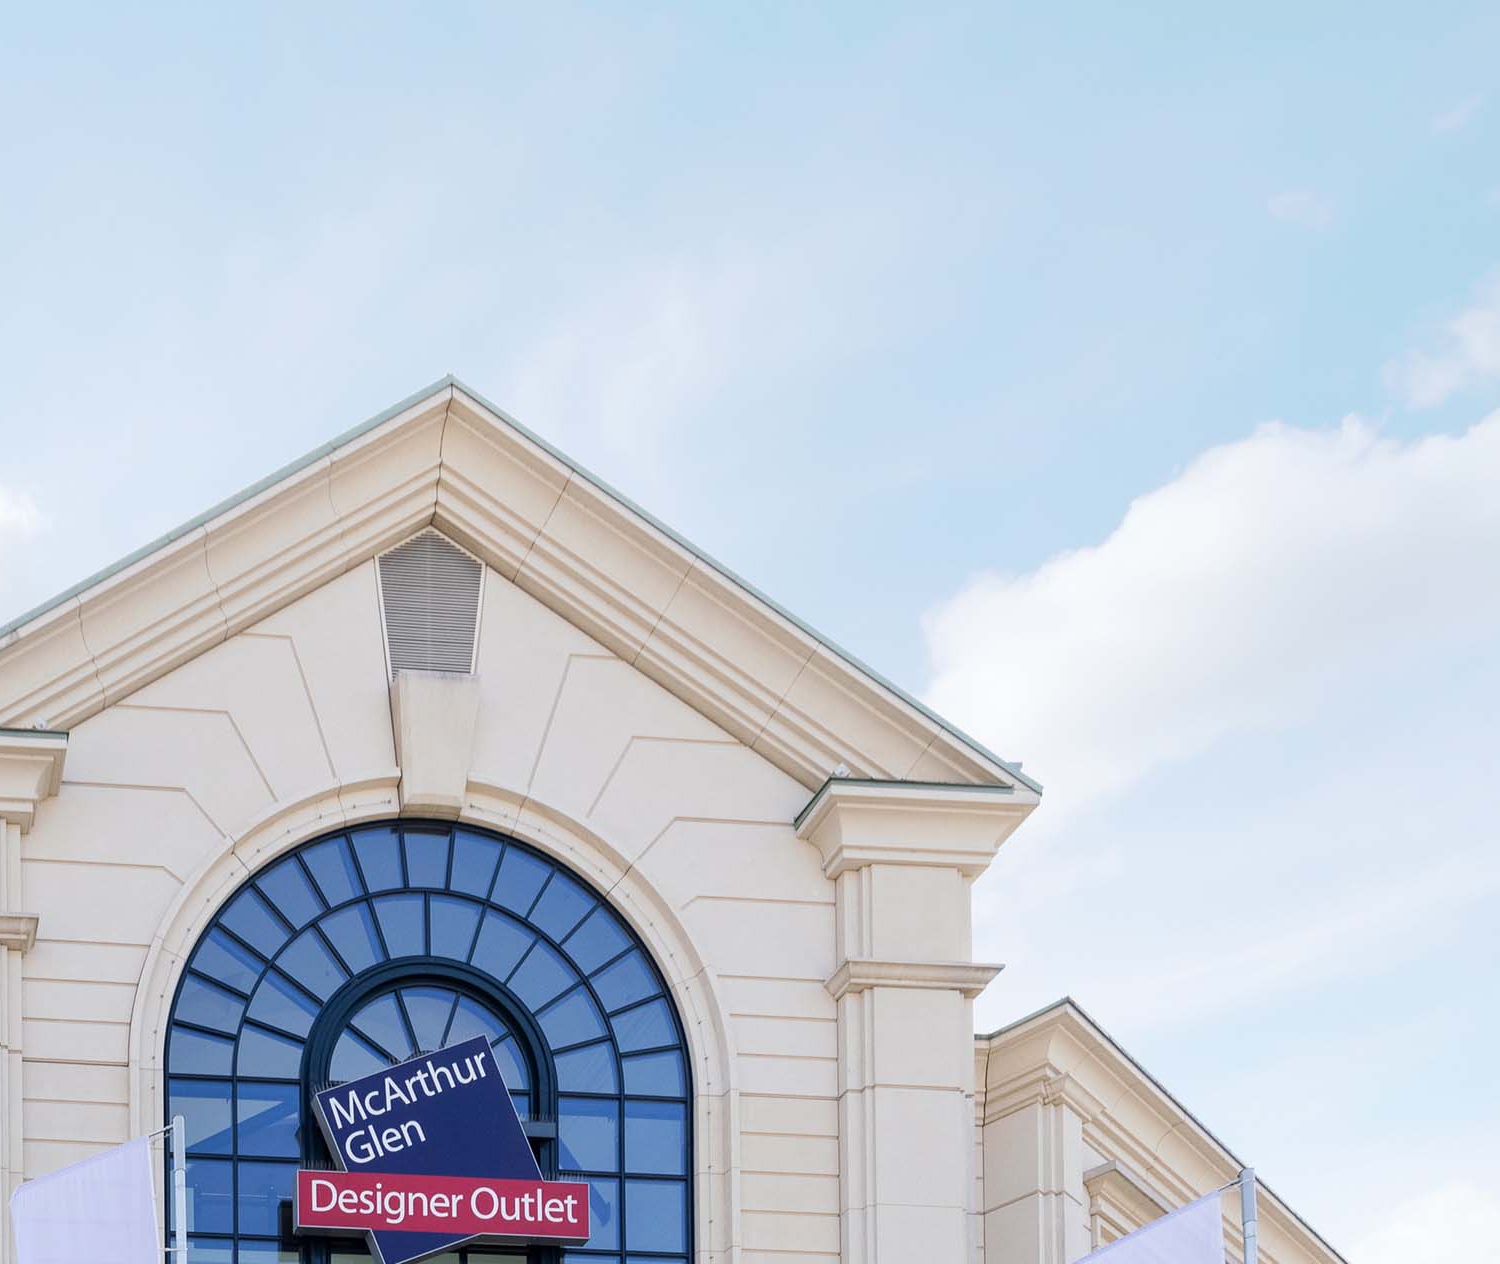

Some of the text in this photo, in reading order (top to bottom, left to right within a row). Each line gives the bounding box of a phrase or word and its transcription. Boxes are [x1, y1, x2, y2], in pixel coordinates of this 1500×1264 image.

[328, 1052, 486, 1130] McArthur
[345, 1119, 426, 1164] Glen
[311, 1180, 578, 1224] Designer Outlet
